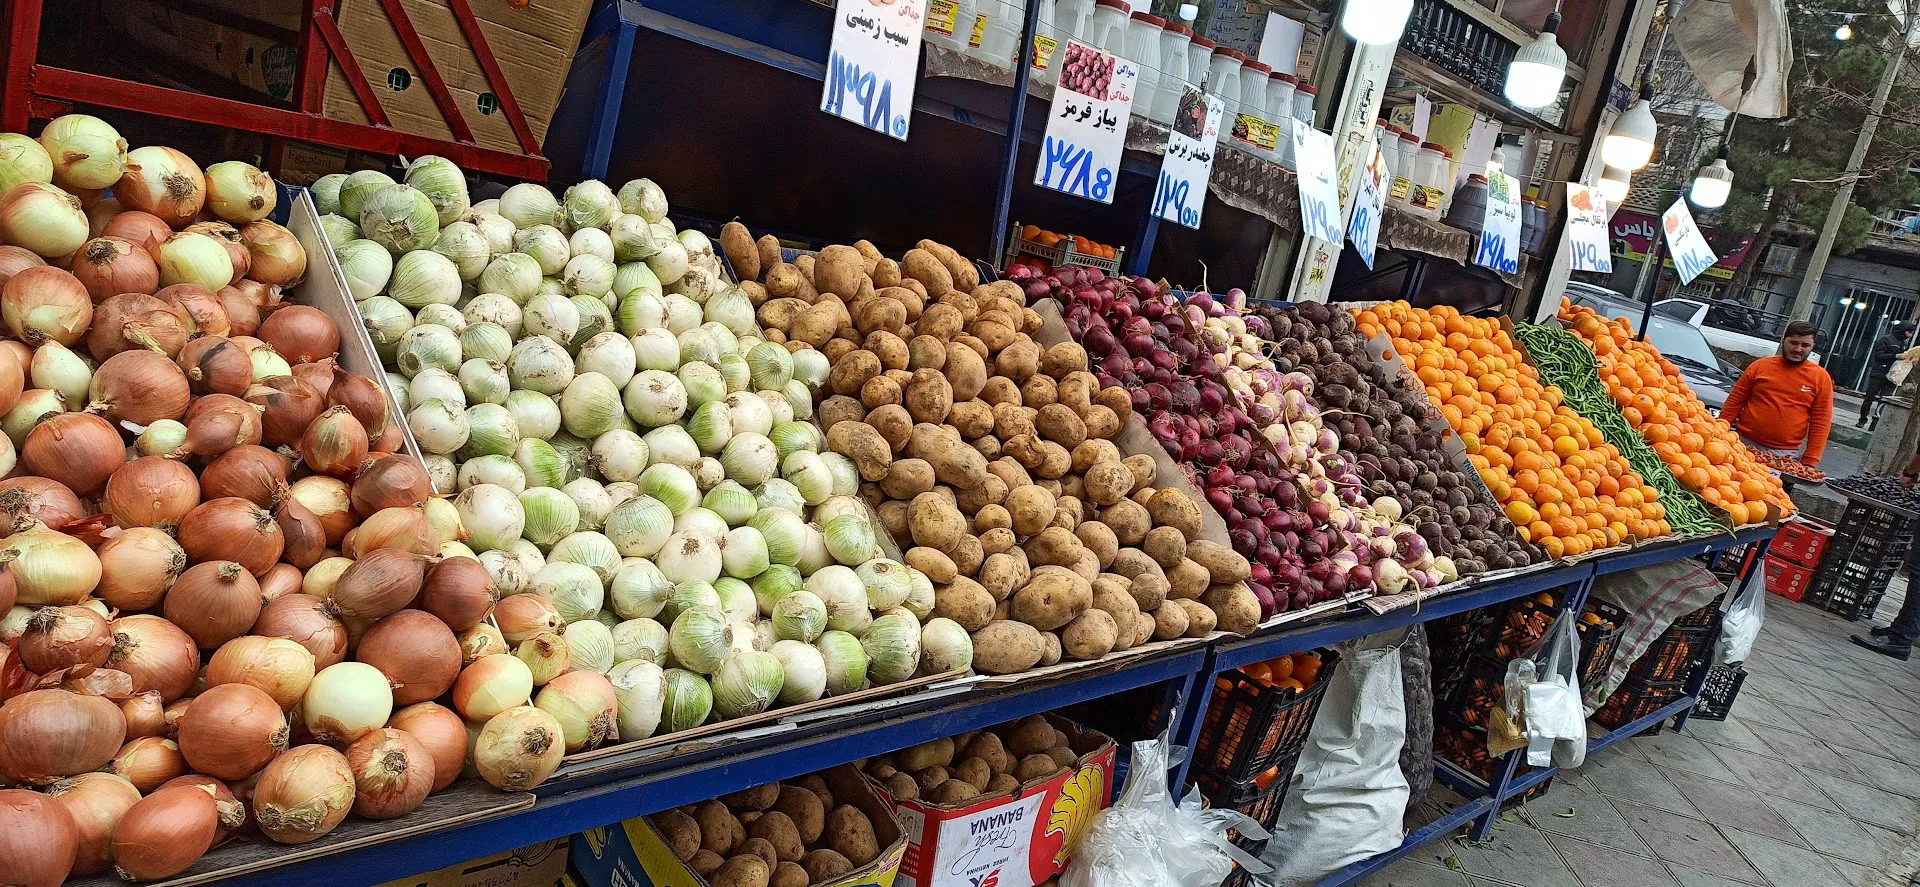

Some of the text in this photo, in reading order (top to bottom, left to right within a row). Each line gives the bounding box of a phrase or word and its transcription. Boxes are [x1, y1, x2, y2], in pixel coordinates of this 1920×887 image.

[845, 9, 909, 48] سیب زمینی
[1059, 100, 1118, 133] پیاز قرمز
[288, 149, 333, 168] Eggplant
[1152, 169, 1199, 227] ۱۲۹۰۰
[1570, 239, 1610, 272] ۱۲۹۰۰
[1463, 458, 1480, 482] CHINA
[971, 806, 1024, 836] BANANA
[951, 827, 1017, 876] Fresh
